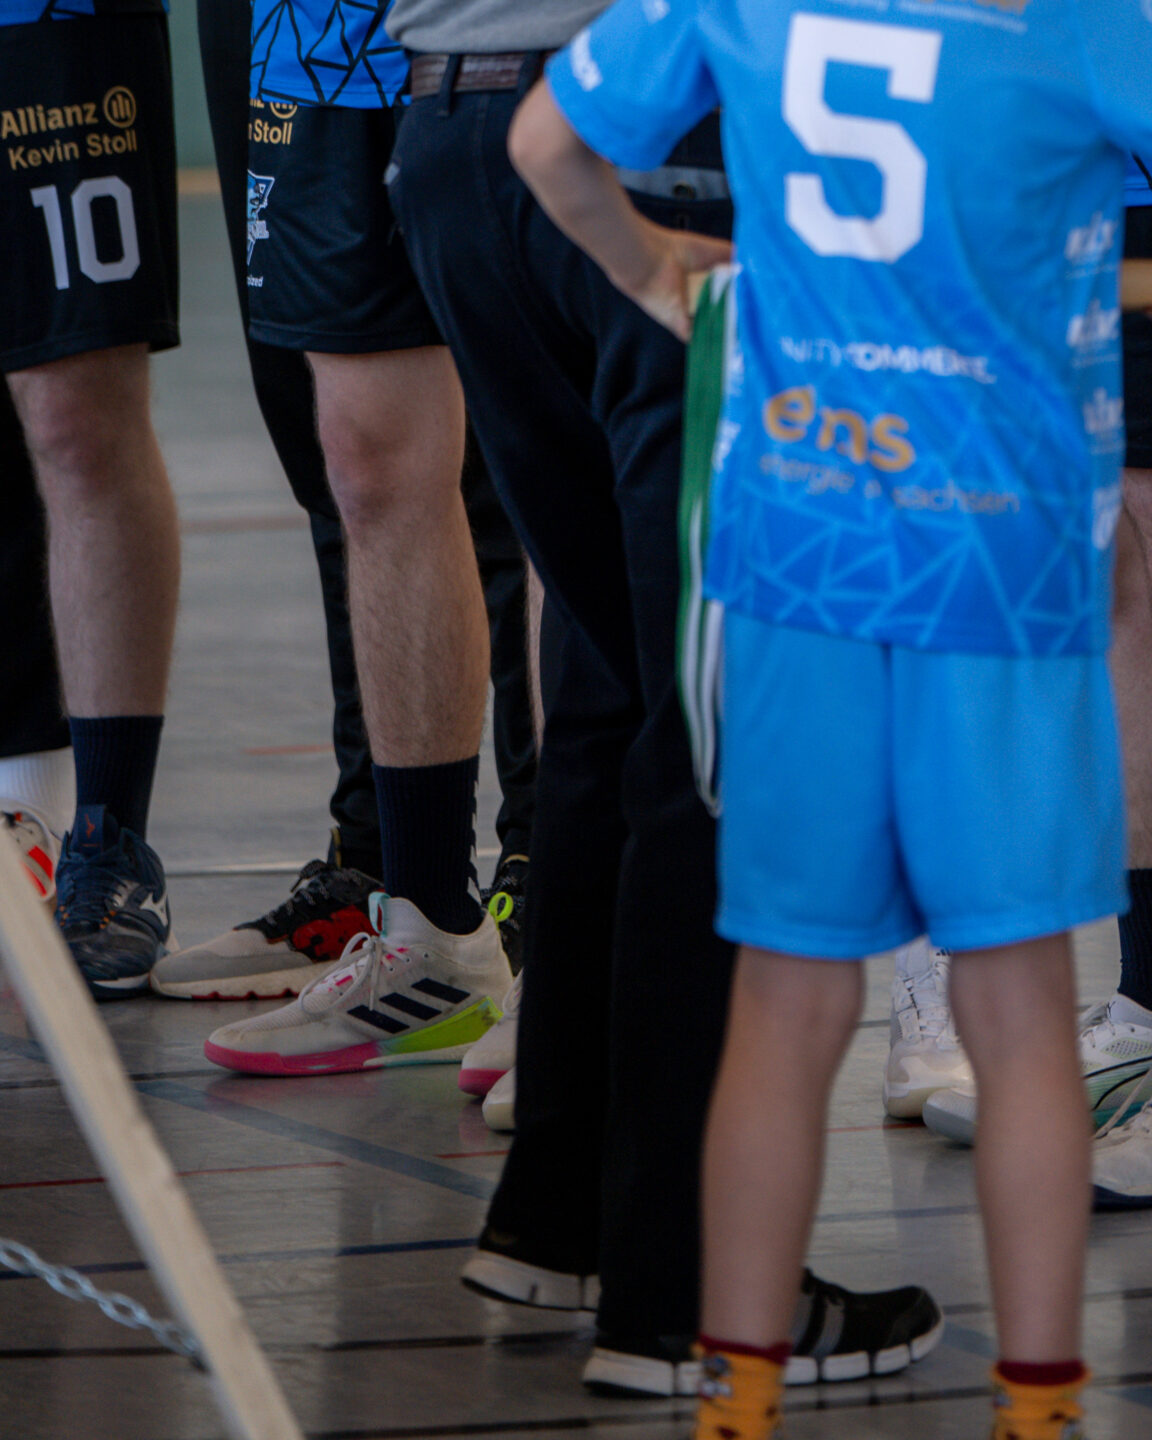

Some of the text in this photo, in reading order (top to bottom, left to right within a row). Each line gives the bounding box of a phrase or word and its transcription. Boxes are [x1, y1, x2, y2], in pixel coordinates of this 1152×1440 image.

[1, 98, 99, 140] Allianz
[8, 129, 138, 172] Kevin Stoll
[253, 117, 293, 145] Stoll
[781, 12, 942, 264] 5
[29, 174, 141, 291] 10
[763, 383, 916, 474] ens
